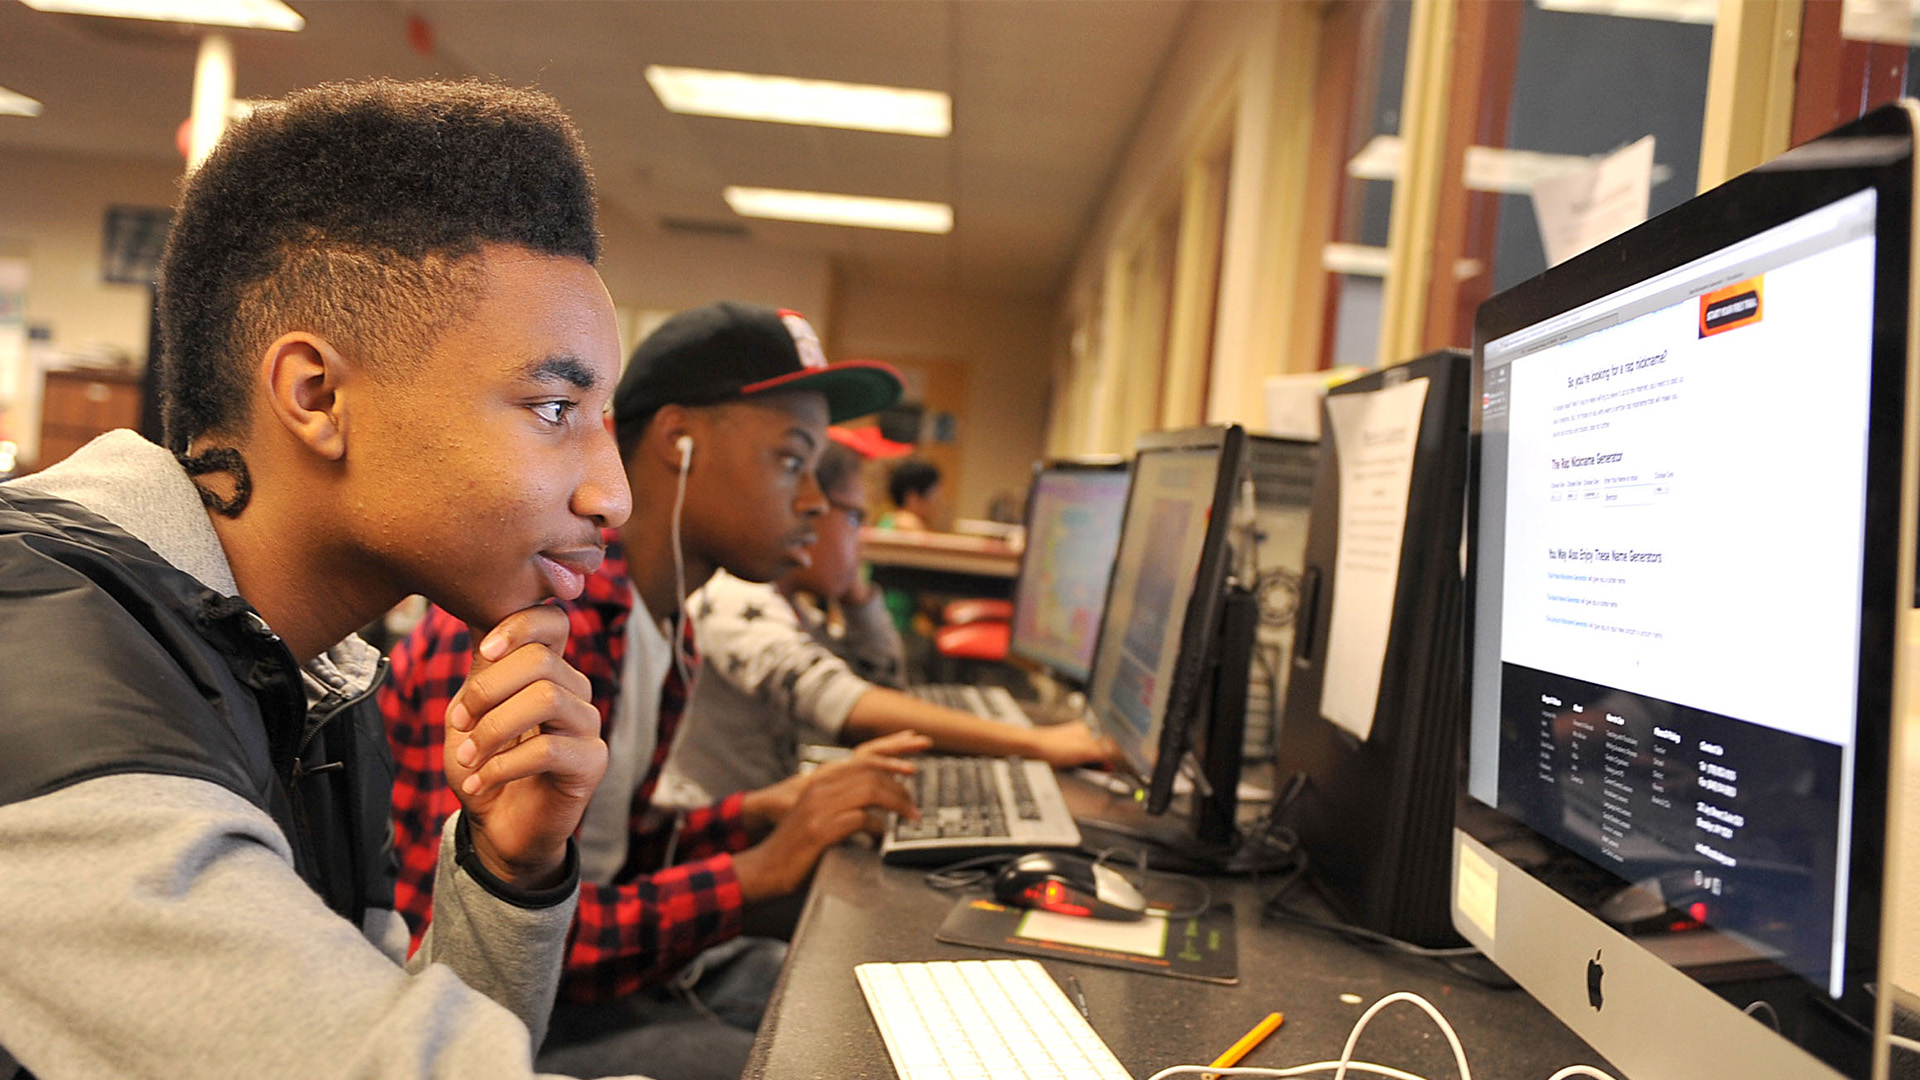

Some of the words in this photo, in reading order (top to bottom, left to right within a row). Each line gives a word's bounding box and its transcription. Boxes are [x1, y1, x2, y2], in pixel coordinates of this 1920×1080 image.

[1591, 367, 1610, 381] looking
[1611, 363, 1619, 377] for
[1625, 361, 1634, 374] rap
[1636, 349, 1668, 370] nickname?
[1552, 458, 1560, 470] The
[1561, 457, 1570, 470] Rap
[1571, 454, 1595, 468] Nickname
[1596, 452, 1623, 465] Generator
[1549, 548, 1557, 561] You
[1558, 548, 1567, 563] May
[1569, 548, 1578, 561] Also
[1580, 548, 1593, 564] Enjoy
[1595, 548, 1610, 562] These
[1612, 549, 1628, 563] Name
[1629, 549, 1662, 564] Generators
